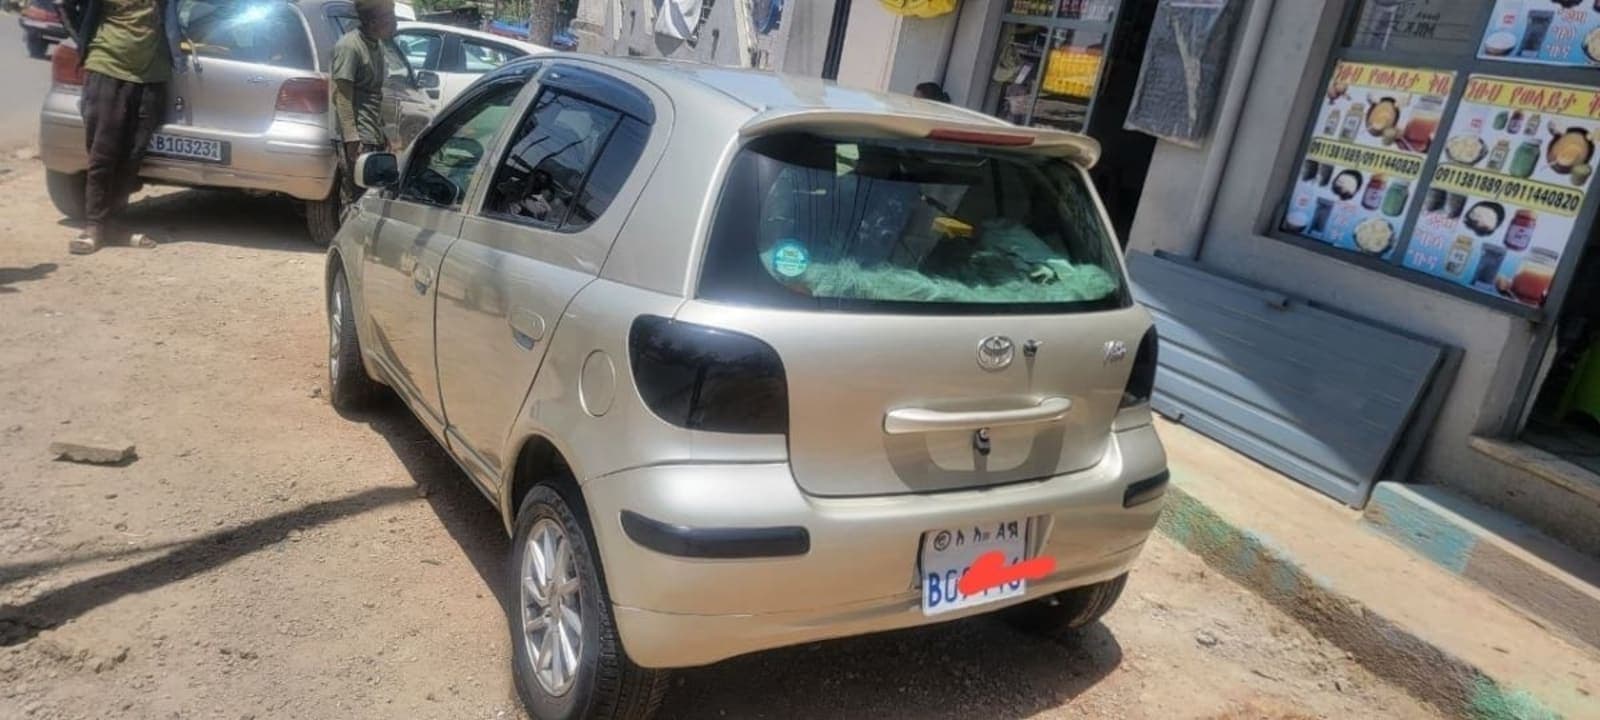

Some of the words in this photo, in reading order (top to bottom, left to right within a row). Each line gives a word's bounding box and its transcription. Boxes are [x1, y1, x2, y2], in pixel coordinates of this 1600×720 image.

[156, 135, 211, 156] B10323
[1309, 141, 1421, 176] 0911381889/0911440820
[1434, 166, 1581, 212] 0911381889/0911440820
